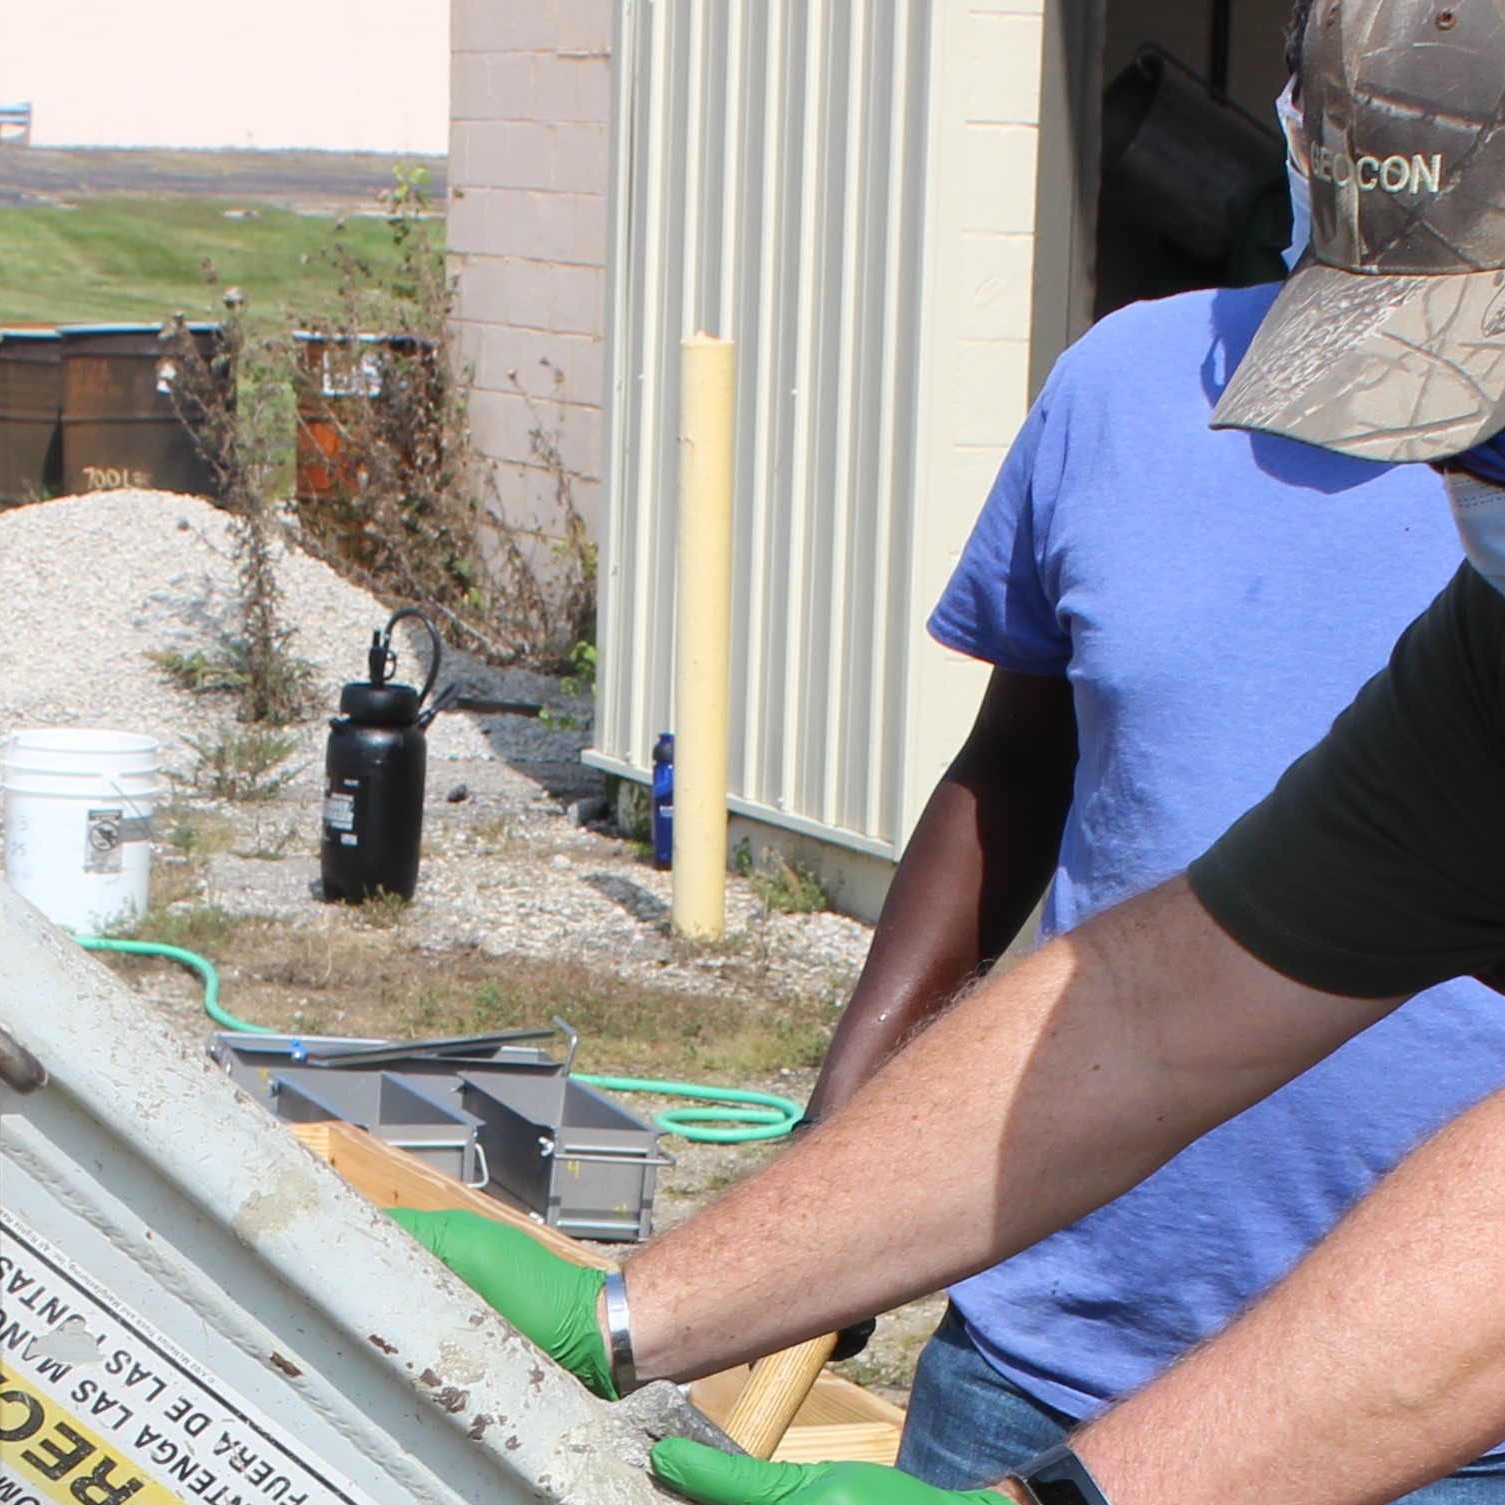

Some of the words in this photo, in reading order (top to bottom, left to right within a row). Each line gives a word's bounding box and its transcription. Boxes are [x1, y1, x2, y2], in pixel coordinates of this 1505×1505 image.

[1311, 140, 1442, 195] GEOCON
[117, 1304, 137, 1322] and
[132, 1316, 159, 1339] Truck
[101, 1344, 170, 1405] LAS
[66, 1374, 135, 1435] LAS
[161, 1392, 213, 1441] DE
